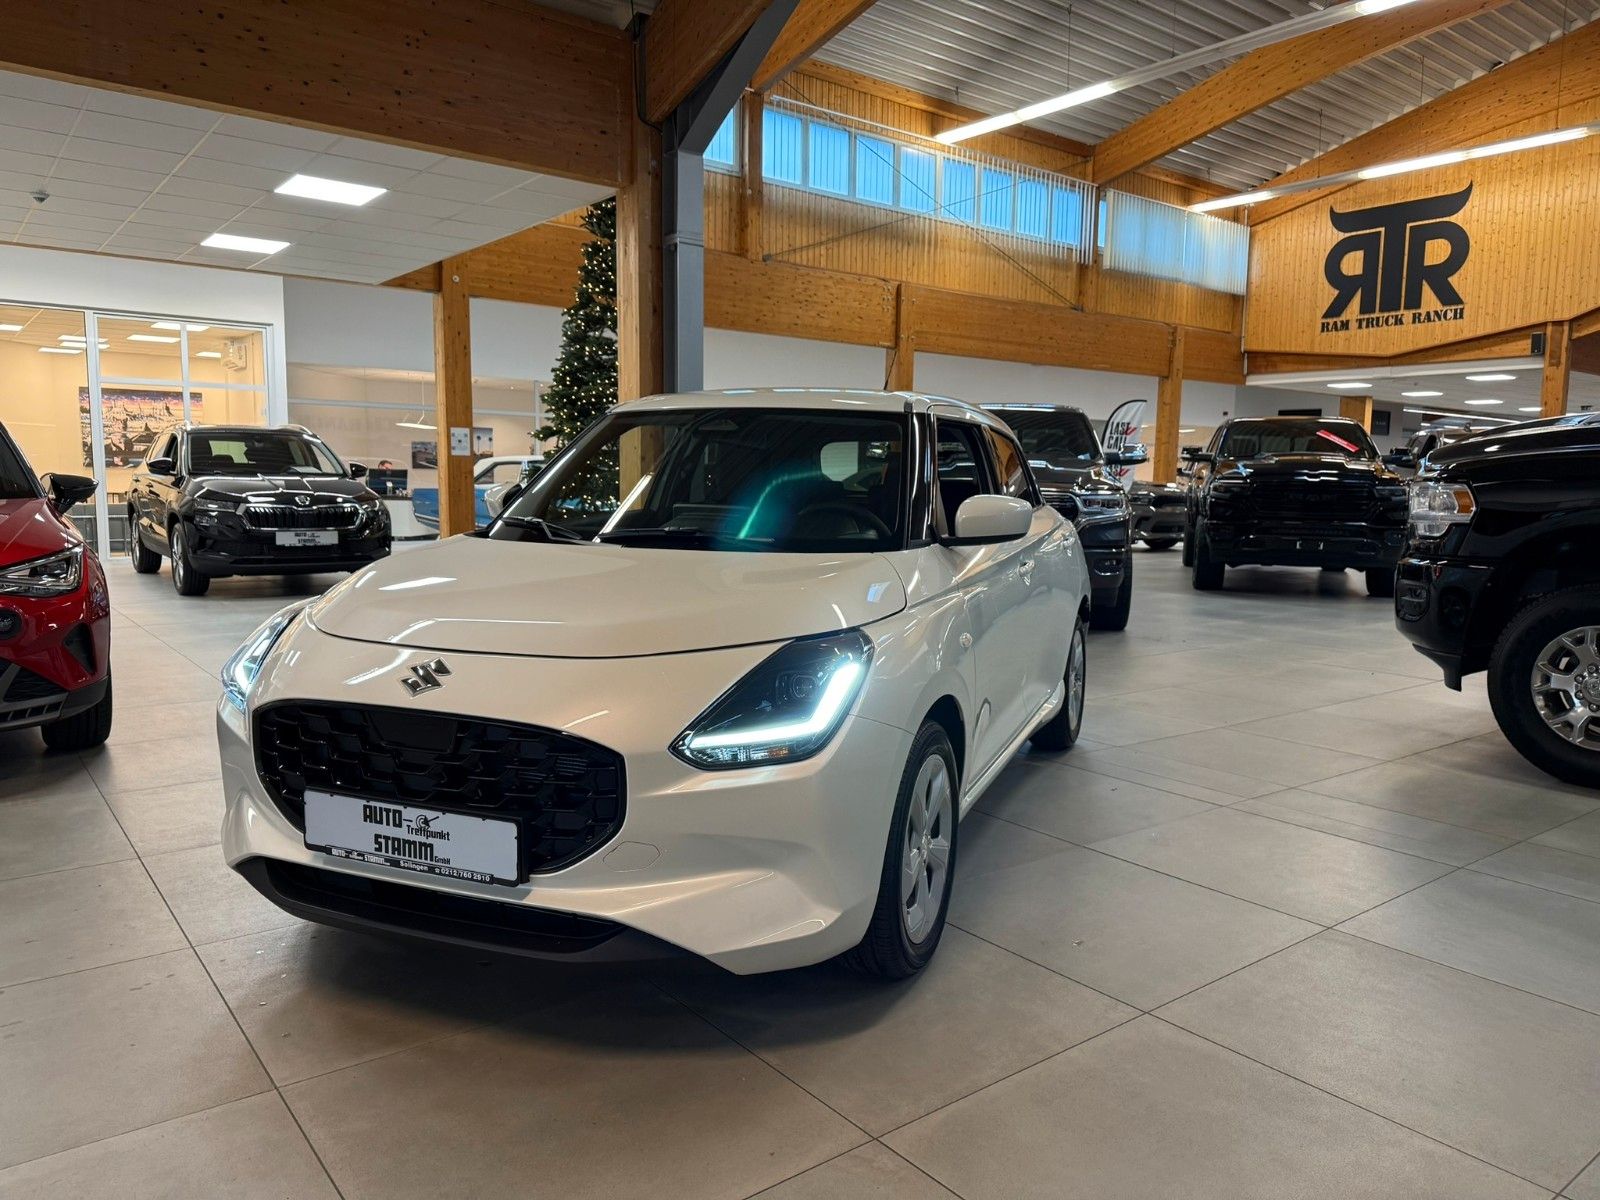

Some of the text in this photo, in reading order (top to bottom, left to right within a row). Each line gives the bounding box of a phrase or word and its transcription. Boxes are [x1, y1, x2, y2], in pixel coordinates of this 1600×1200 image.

[1320, 308, 1465, 333] RAM TRUCK RANCH
[1110, 421, 1131, 436] LAST
[406, 824, 450, 841] Treffpunkt
[374, 833, 434, 862] STAMM
[400, 860, 429, 872] Solingen
[440, 867, 472, 879] 0212/760
